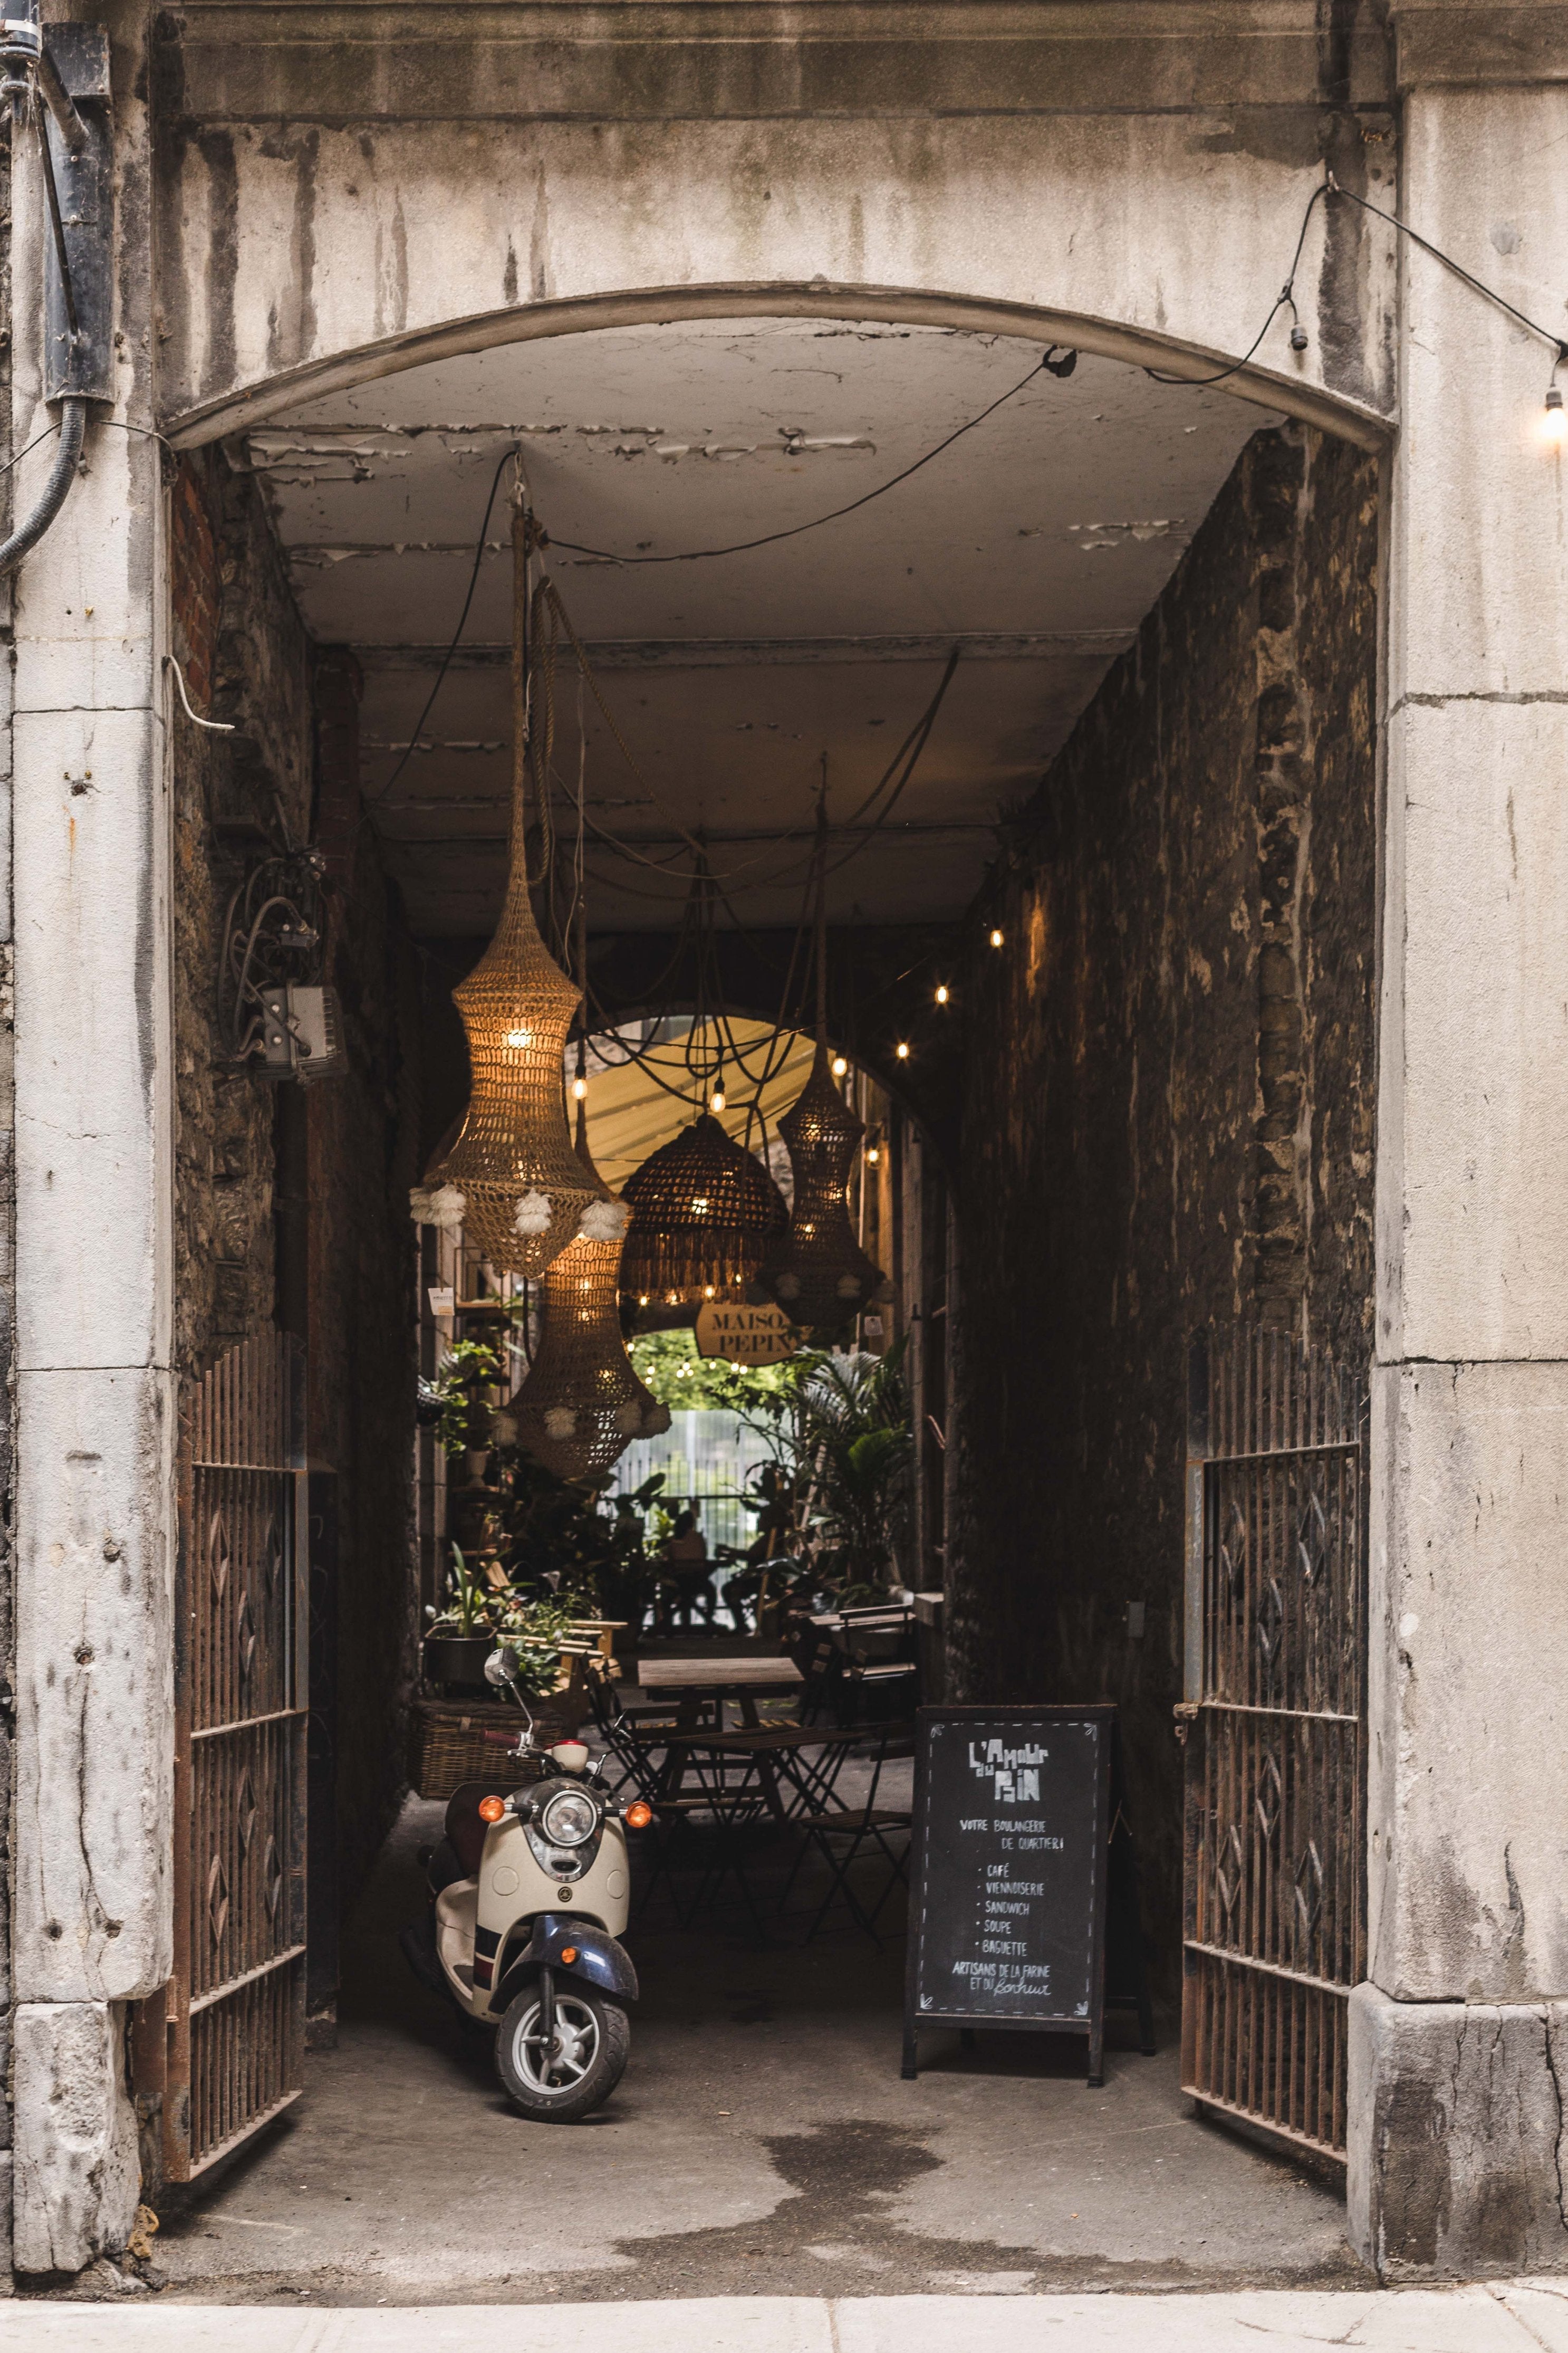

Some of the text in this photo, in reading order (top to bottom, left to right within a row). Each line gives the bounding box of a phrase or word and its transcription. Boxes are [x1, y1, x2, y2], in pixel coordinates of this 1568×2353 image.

[713, 1313, 786, 1330] MAISO
[719, 1334, 791, 1352] PEPIN
[959, 1820, 1046, 1832] VOTRE BOULANGERIE
[1002, 1838, 1014, 1850] DE
[987, 1863, 1009, 1878] CAFÉ
[986, 1882, 1045, 1896] VIENNOISERIE
[985, 1900, 1030, 1915] SANDWICH
[984, 1919, 1012, 1934] SOUPE
[982, 1939, 1027, 1956] BAGUETTE
[952, 1961, 1051, 1978] ARTISANS DE LA FARINE
[970, 1977, 982, 1990] ET
[984, 1977, 995, 1990] DU
